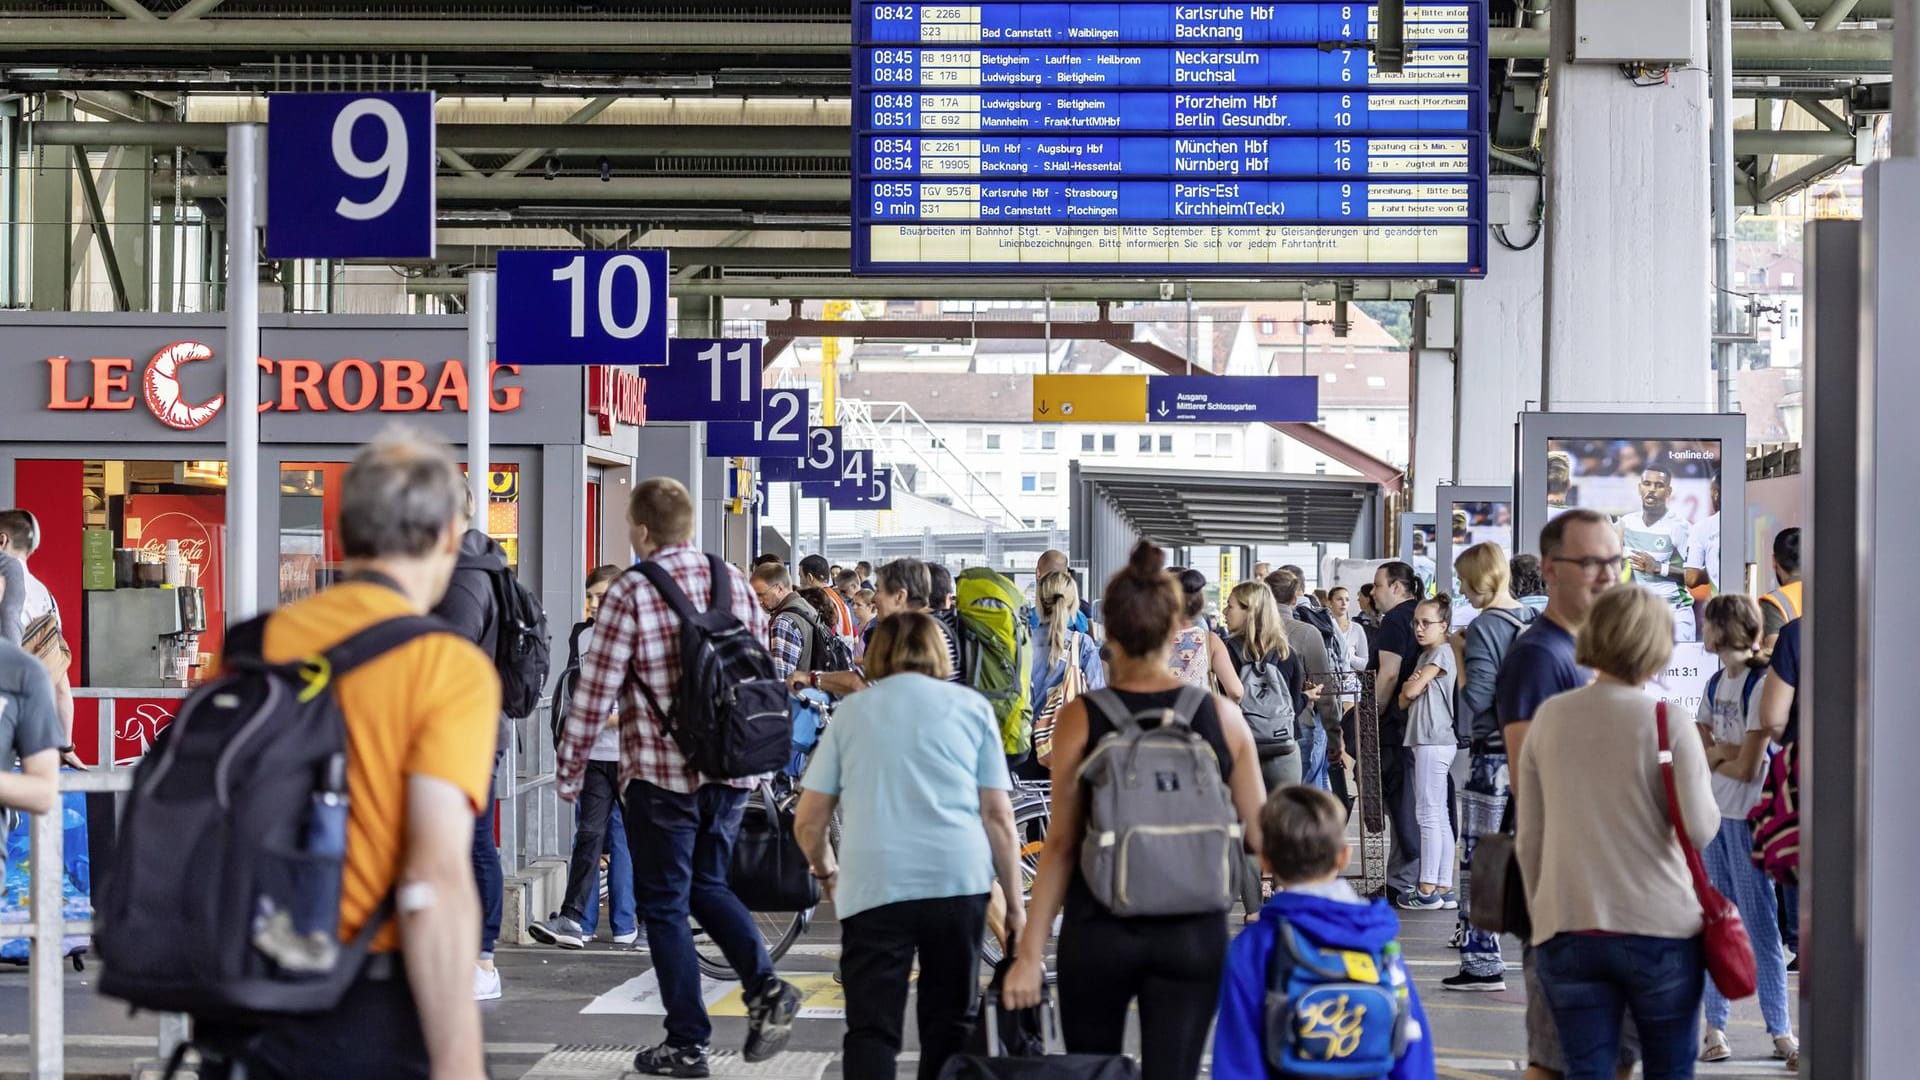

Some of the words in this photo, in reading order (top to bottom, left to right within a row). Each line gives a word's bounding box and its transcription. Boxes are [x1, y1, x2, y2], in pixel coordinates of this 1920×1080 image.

[875, 7, 912, 19] 08:42
[921, 9, 933, 19] IC
[936, 9, 961, 19] 2266
[1176, 7, 1243, 19] Karlsruhe
[1251, 7, 1274, 19] Hbf
[1342, 7, 1351, 19] 8
[1422, 9, 1444, 17] Bitte
[1447, 9, 1468, 17] infor
[921, 27, 941, 36] S23
[982, 28, 1000, 37] Bad
[1005, 28, 1051, 37] Cannstatt
[1068, 28, 1118, 39] Waiblingen
[1176, 24, 1242, 40] Backnang
[1342, 24, 1350, 37] 4
[875, 51, 912, 63] 08:45
[921, 53, 938, 63] RB
[940, 53, 971, 63] 19110
[982, 55, 1029, 66] Bietigheim
[1046, 55, 1081, 64] Lauffen
[1098, 55, 1140, 64] Heilbronn
[1176, 51, 1258, 64] Neckarsulm
[1343, 51, 1350, 64] 7
[875, 69, 912, 81] 08:48
[921, 71, 934, 81] RE
[940, 71, 958, 81] 17B
[982, 73, 1041, 84] Ludwigsburg
[1058, 73, 1104, 84] Bietigheim
[1176, 69, 1236, 81] Bruchsal
[1342, 69, 1350, 81] 6
[1385, 71, 1406, 79] nach
[875, 95, 912, 108] 08:48
[921, 98, 934, 108] RB
[941, 98, 959, 108] 17A
[982, 100, 1041, 110] Ludwigsburg
[1058, 100, 1105, 110] Bietigheim
[1176, 95, 1246, 108] Pforzheim
[1254, 95, 1277, 108] Hbf
[1342, 95, 1350, 108] 6
[1368, 98, 1396, 107] ugteil
[875, 113, 911, 125] 08:51
[921, 116, 936, 125] ICE
[941, 116, 960, 125] 692
[982, 117, 1028, 126] Mannheim
[1045, 117, 1120, 126] Frankfurt(M)Hbf
[1176, 113, 1214, 126] Berlin
[1223, 113, 1290, 126] Gesundbr.
[1335, 113, 1350, 126] 10
[875, 140, 912, 152] 08:54
[921, 143, 933, 152] IC
[935, 143, 960, 152] 2261
[982, 144, 999, 152] Ulm
[1005, 144, 1020, 153] Hbf
[1038, 144, 1082, 155] Augsburg
[1087, 144, 1103, 153] Hbf
[1176, 140, 1237, 153] München
[1245, 140, 1267, 153] Hbf
[1335, 140, 1350, 153] 15
[331, 98, 409, 220] 9
[875, 157, 912, 170] 08:54
[921, 160, 936, 170] RE
[940, 160, 970, 170] 19905
[1335, 158, 1350, 170] 16
[982, 162, 1027, 172] Backnang
[1044, 162, 1121, 170] S.Hall-Hessental
[1176, 158, 1238, 174] Nürnberg
[1246, 158, 1268, 170] Hbf
[875, 184, 912, 196] 08:55
[922, 186, 942, 196] TGV
[947, 186, 971, 196] 9576
[982, 188, 1027, 197] Karlsruhe
[1033, 188, 1048, 197] Hbf
[1065, 188, 1117, 199] Strasbourg
[1176, 184, 1238, 197] Paris-Est
[1342, 185, 1350, 197] 9
[875, 202, 882, 214] 9
[891, 202, 914, 214] min
[921, 205, 940, 214] S31
[982, 206, 999, 214] Bad
[1005, 206, 1051, 214] Cannstatt
[1068, 206, 1117, 217] Plochingen
[1176, 202, 1284, 215] Kirchheim(Teck)
[1342, 202, 1350, 214] 5
[900, 227, 956, 236] Bauarbeiten
[960, 227, 971, 236] im
[976, 227, 1013, 236] Bahnhof
[1104, 227, 1117, 236] bis
[1122, 227, 1147, 236] Mitte
[1211, 227, 1222, 236] Es
[1228, 227, 1260, 236] kommt
[1266, 227, 1277, 236] zu
[1363, 227, 1379, 236] und
[1099, 239, 1121, 247] Bitte
[1127, 239, 1179, 247] informieren
[1184, 239, 1198, 247] Sie
[1204, 239, 1222, 247] sich
[1228, 239, 1242, 247] vor
[1247, 239, 1277, 250] jedem
[551, 254, 652, 340] 10
[698, 342, 752, 402] 11
[47, 357, 136, 411] LE
[616, 368, 647, 427] CROBAG
[1177, 393, 1208, 402] Ausgang
[1176, 402, 1206, 410] Mittlerer
[1207, 402, 1257, 412] Schlossgarten
[797, 428, 835, 470] 3
[1668, 450, 1715, 460] t-online.de
[143, 537, 207, 562] CocCola
[1682, 667, 1698, 677] 3:1
